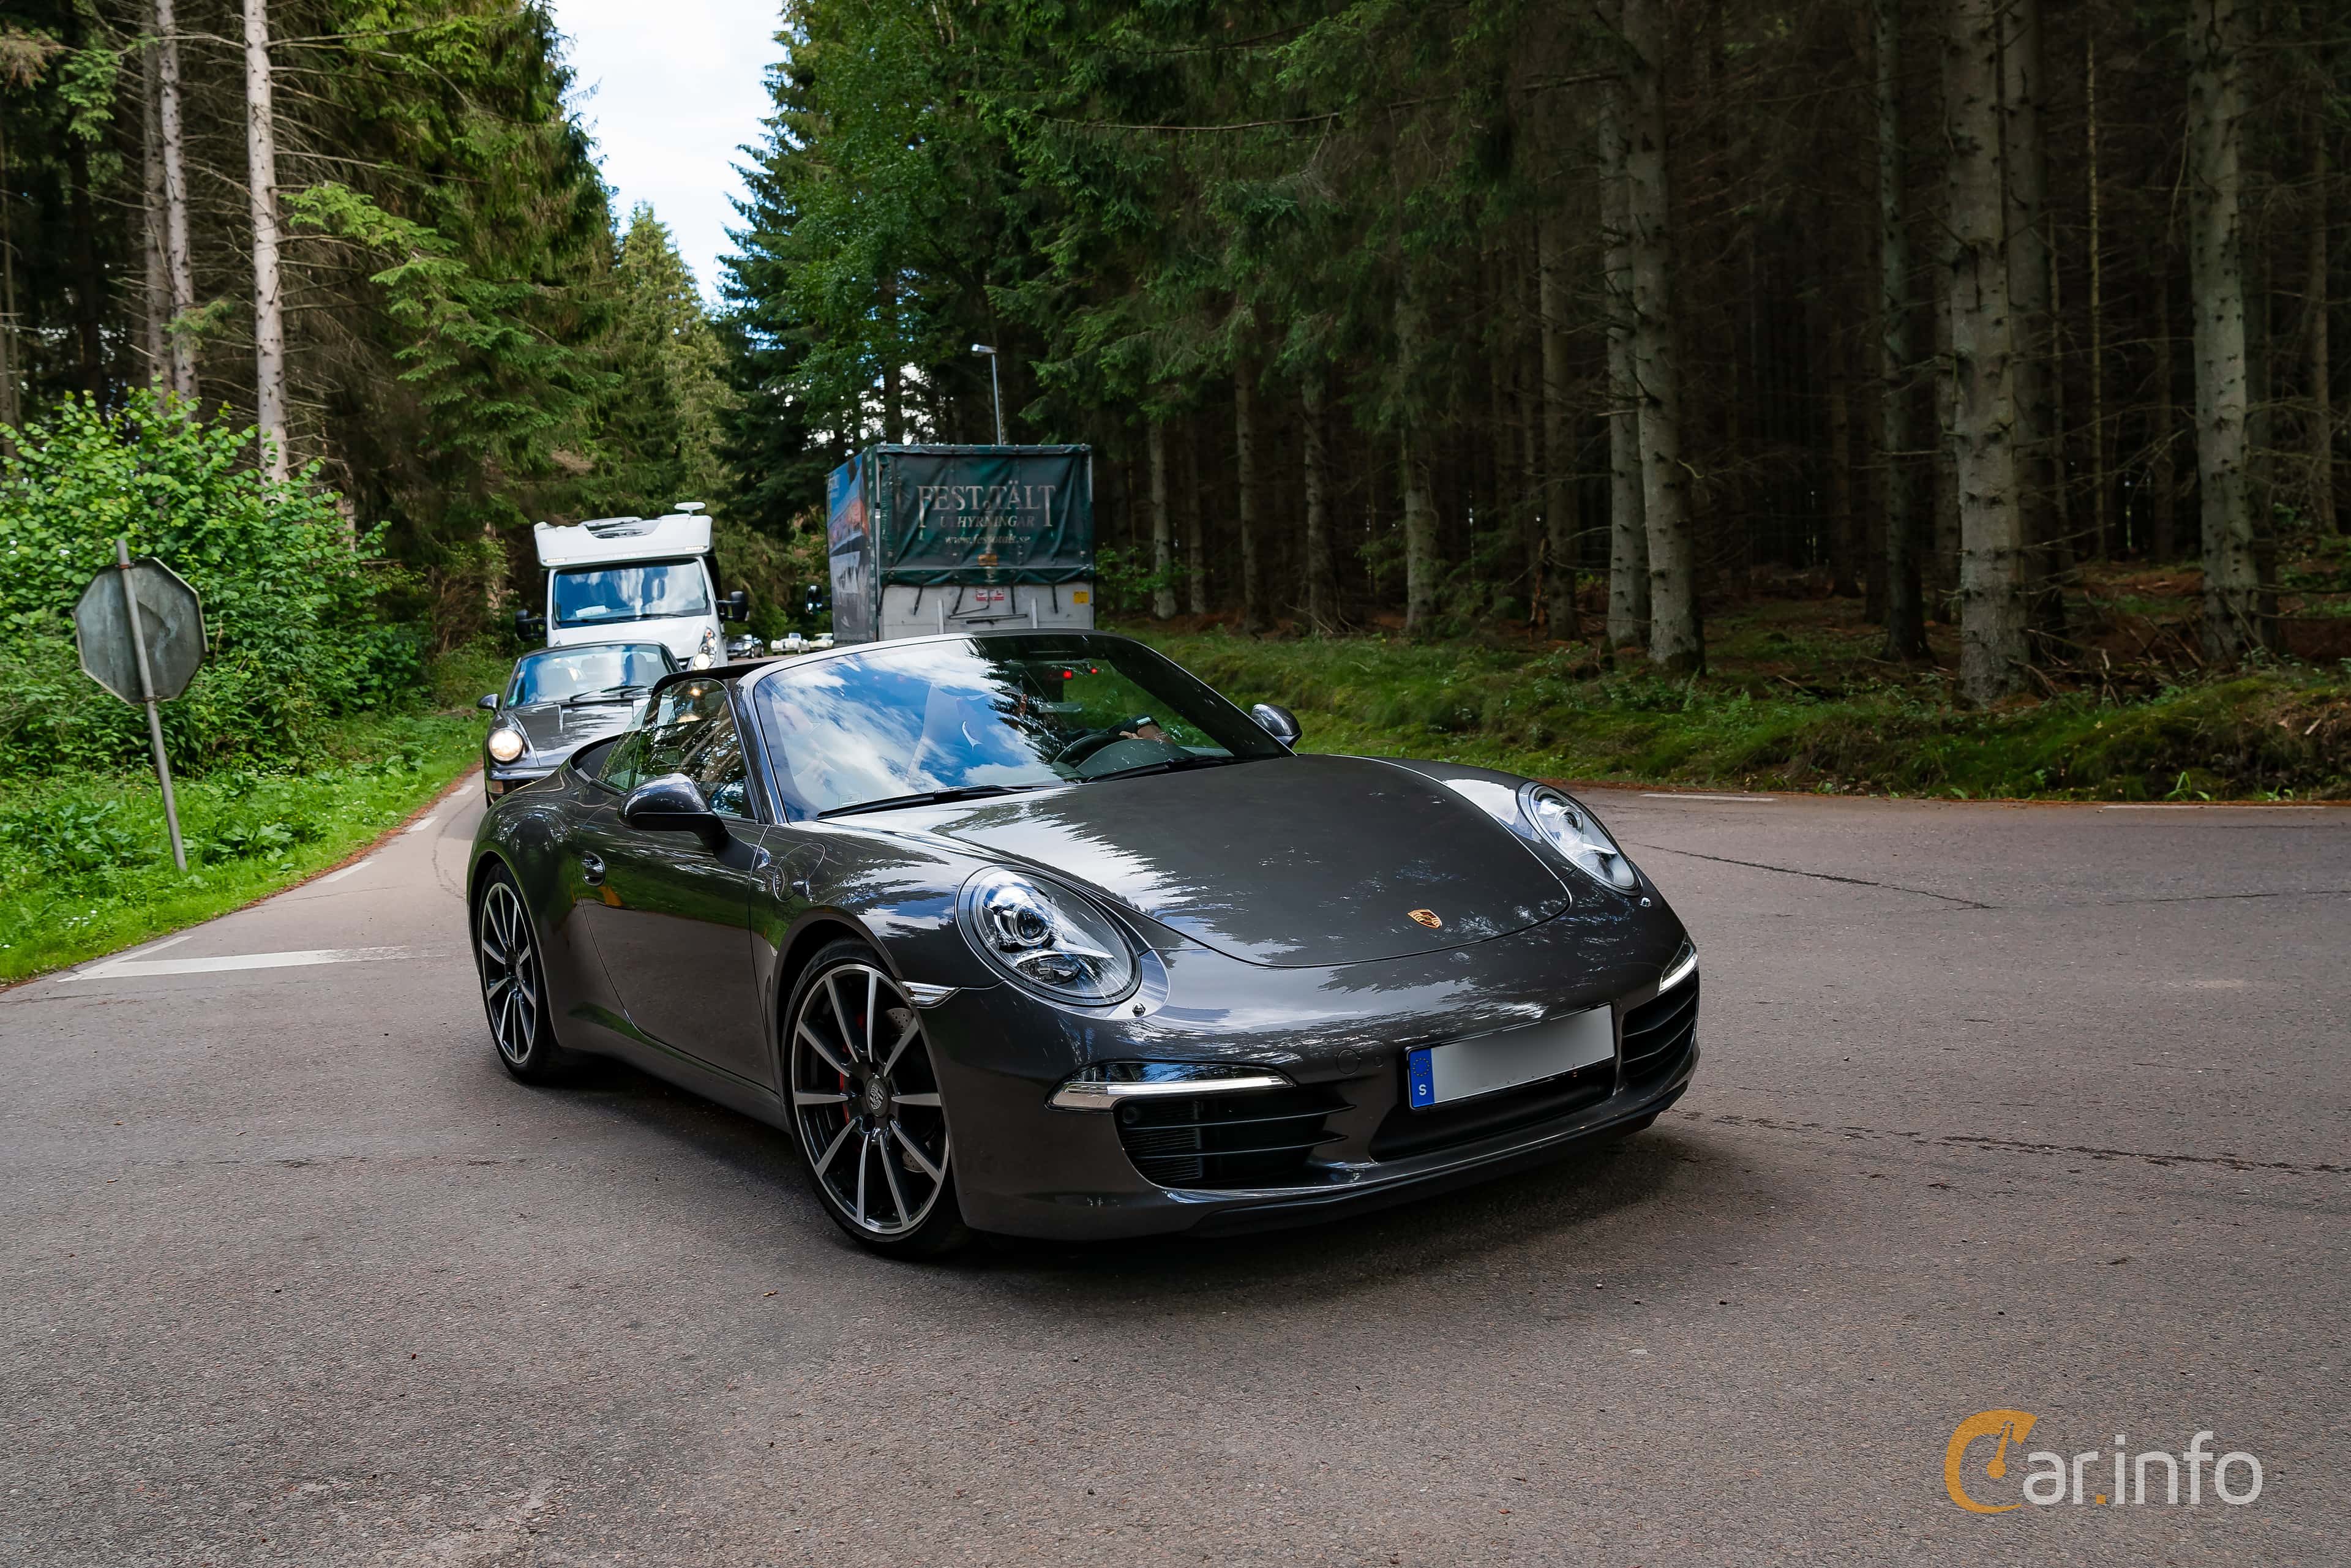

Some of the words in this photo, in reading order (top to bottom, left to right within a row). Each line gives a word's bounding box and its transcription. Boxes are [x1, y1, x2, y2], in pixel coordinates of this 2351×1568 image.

[917, 485, 983, 528] FEST
[989, 480, 1056, 527] TÄLT
[1419, 1084, 1427, 1096] S
